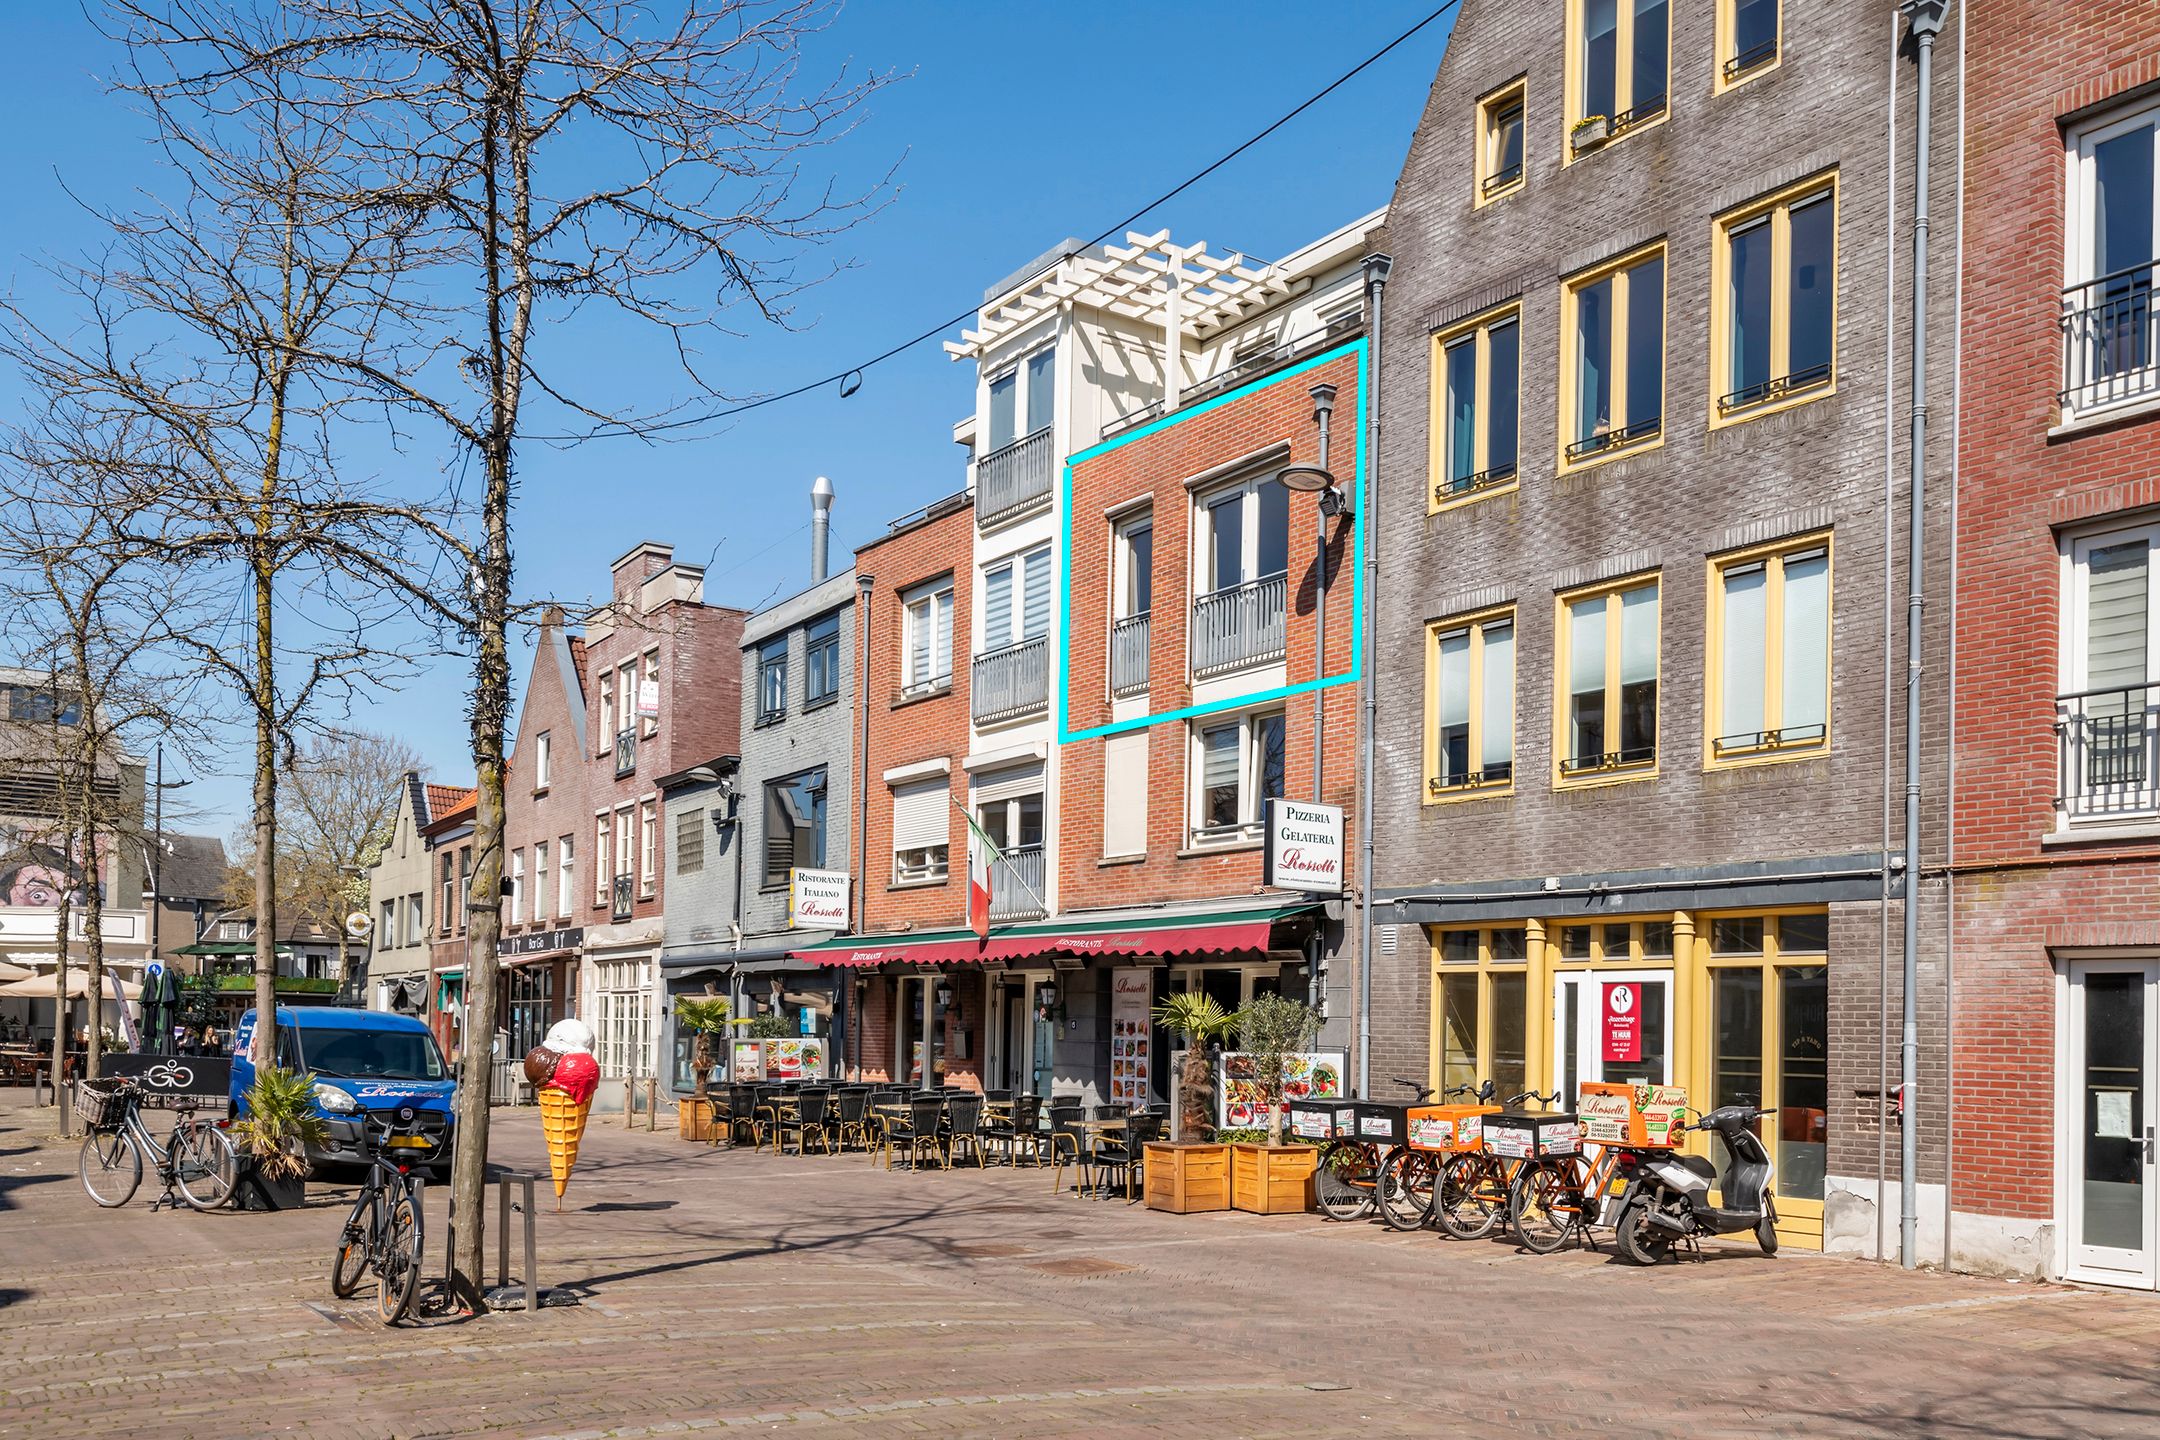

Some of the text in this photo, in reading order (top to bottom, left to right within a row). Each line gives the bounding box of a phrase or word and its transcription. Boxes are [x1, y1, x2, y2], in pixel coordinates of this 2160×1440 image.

[1287, 806, 1330, 824] PIZZERIA
[1281, 827, 1334, 845] GELATERIA
[1278, 847, 1337, 873] Rossetti
[798, 873, 845, 884] RISTORANTE
[804, 887, 839, 898] ITALIANO
[798, 900, 845, 917] Rossetti
[1055, 938, 1104, 948] RISTORANTE
[1115, 977, 1148, 993] Rossetti
[1584, 1097, 1624, 1115] Rossetti
[1650, 1089, 1687, 1106] Rossetti
[1495, 1128, 1521, 1140] Rossetti
